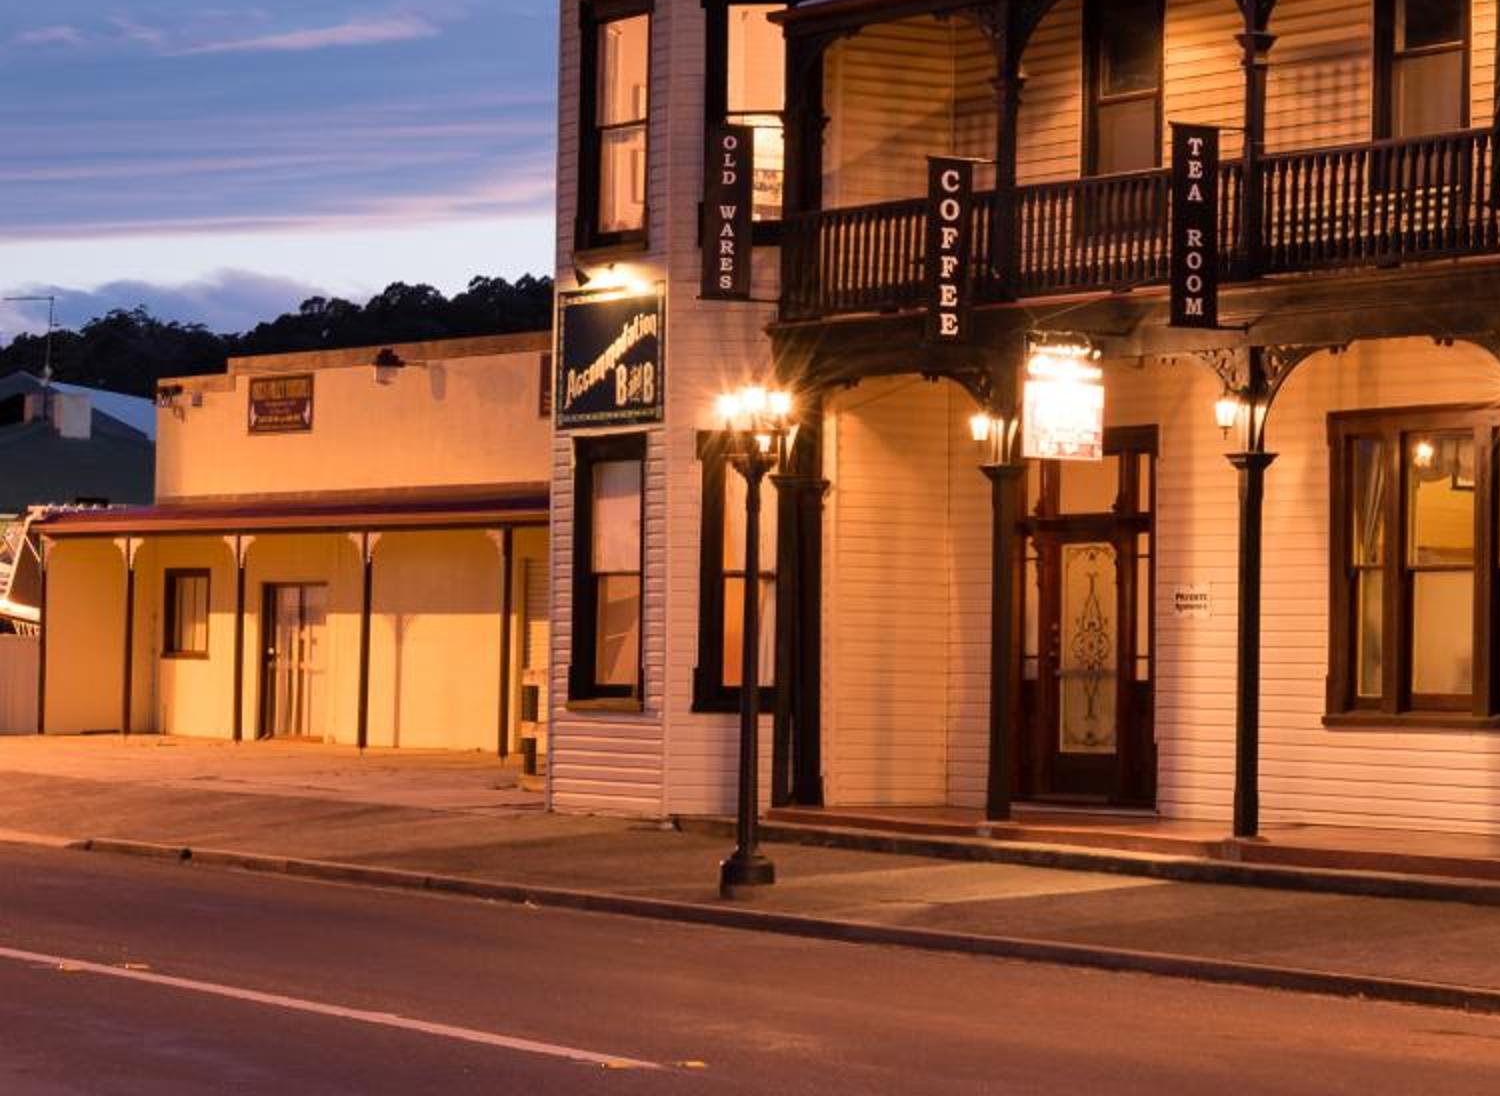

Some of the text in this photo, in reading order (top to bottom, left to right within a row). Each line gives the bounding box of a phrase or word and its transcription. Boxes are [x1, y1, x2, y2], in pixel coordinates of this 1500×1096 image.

[719, 135, 738, 289] OLD WARES
[940, 169, 960, 335] COFFEE
[1185, 137, 1203, 315] TEA ROOM
[615, 364, 628, 406] B
[643, 361, 654, 403] B
